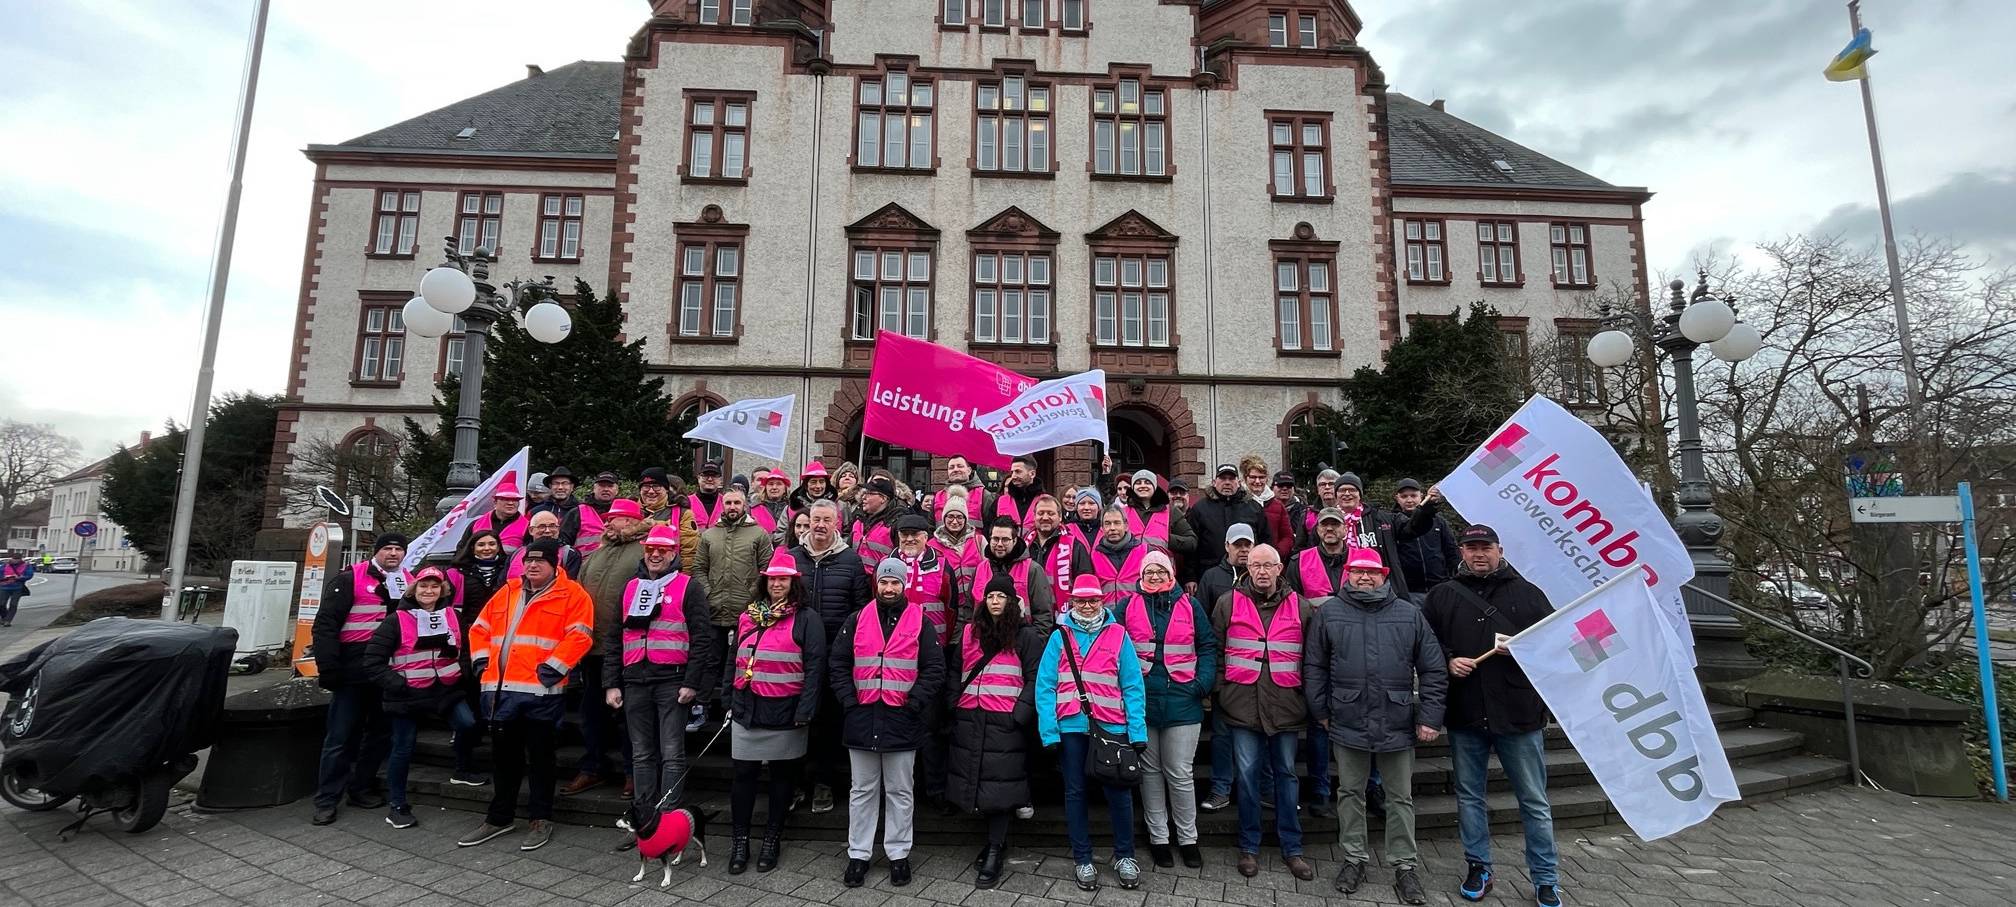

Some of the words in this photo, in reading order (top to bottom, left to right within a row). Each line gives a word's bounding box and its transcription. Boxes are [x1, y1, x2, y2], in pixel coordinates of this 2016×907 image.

[872, 381, 967, 432] Leistung
[639, 589, 652, 611] dbb
[1601, 682, 1704, 803] dbb
